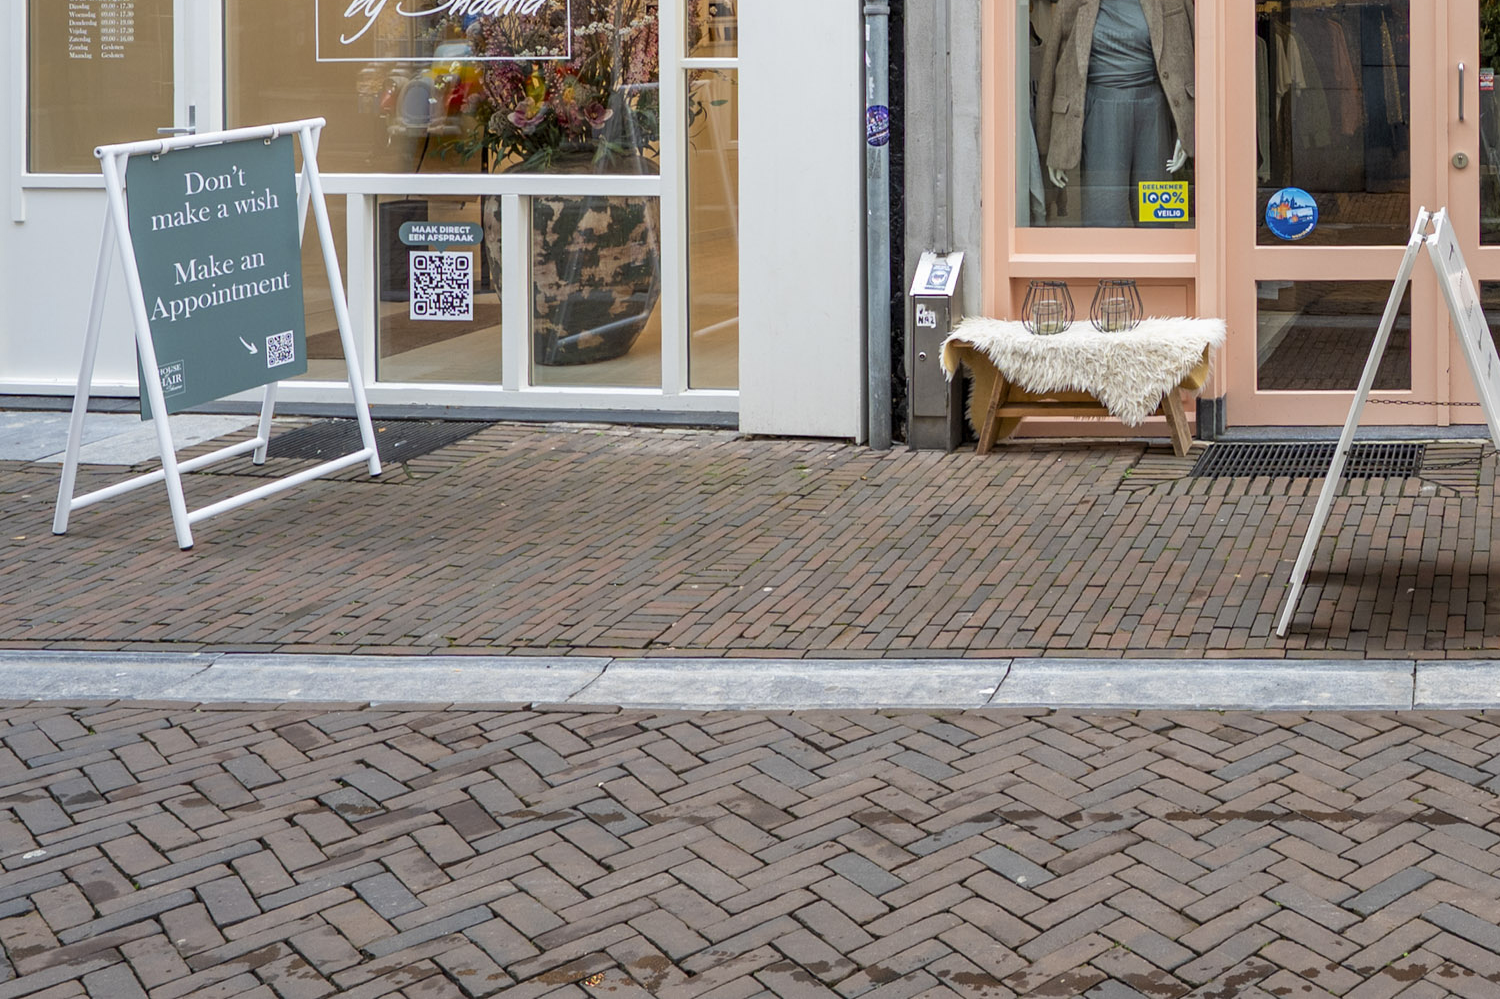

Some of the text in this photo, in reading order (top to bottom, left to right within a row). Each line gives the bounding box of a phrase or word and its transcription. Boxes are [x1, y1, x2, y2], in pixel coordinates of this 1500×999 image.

[184, 165, 247, 196] Don't
[151, 188, 279, 231] make a wish
[1142, 192, 1185, 205] 100%
[411, 225, 471, 234] MAAK DIRECT
[427, 234, 474, 242] AFSPRAAK
[173, 252, 265, 286] Make an
[150, 271, 292, 322] Appointment
